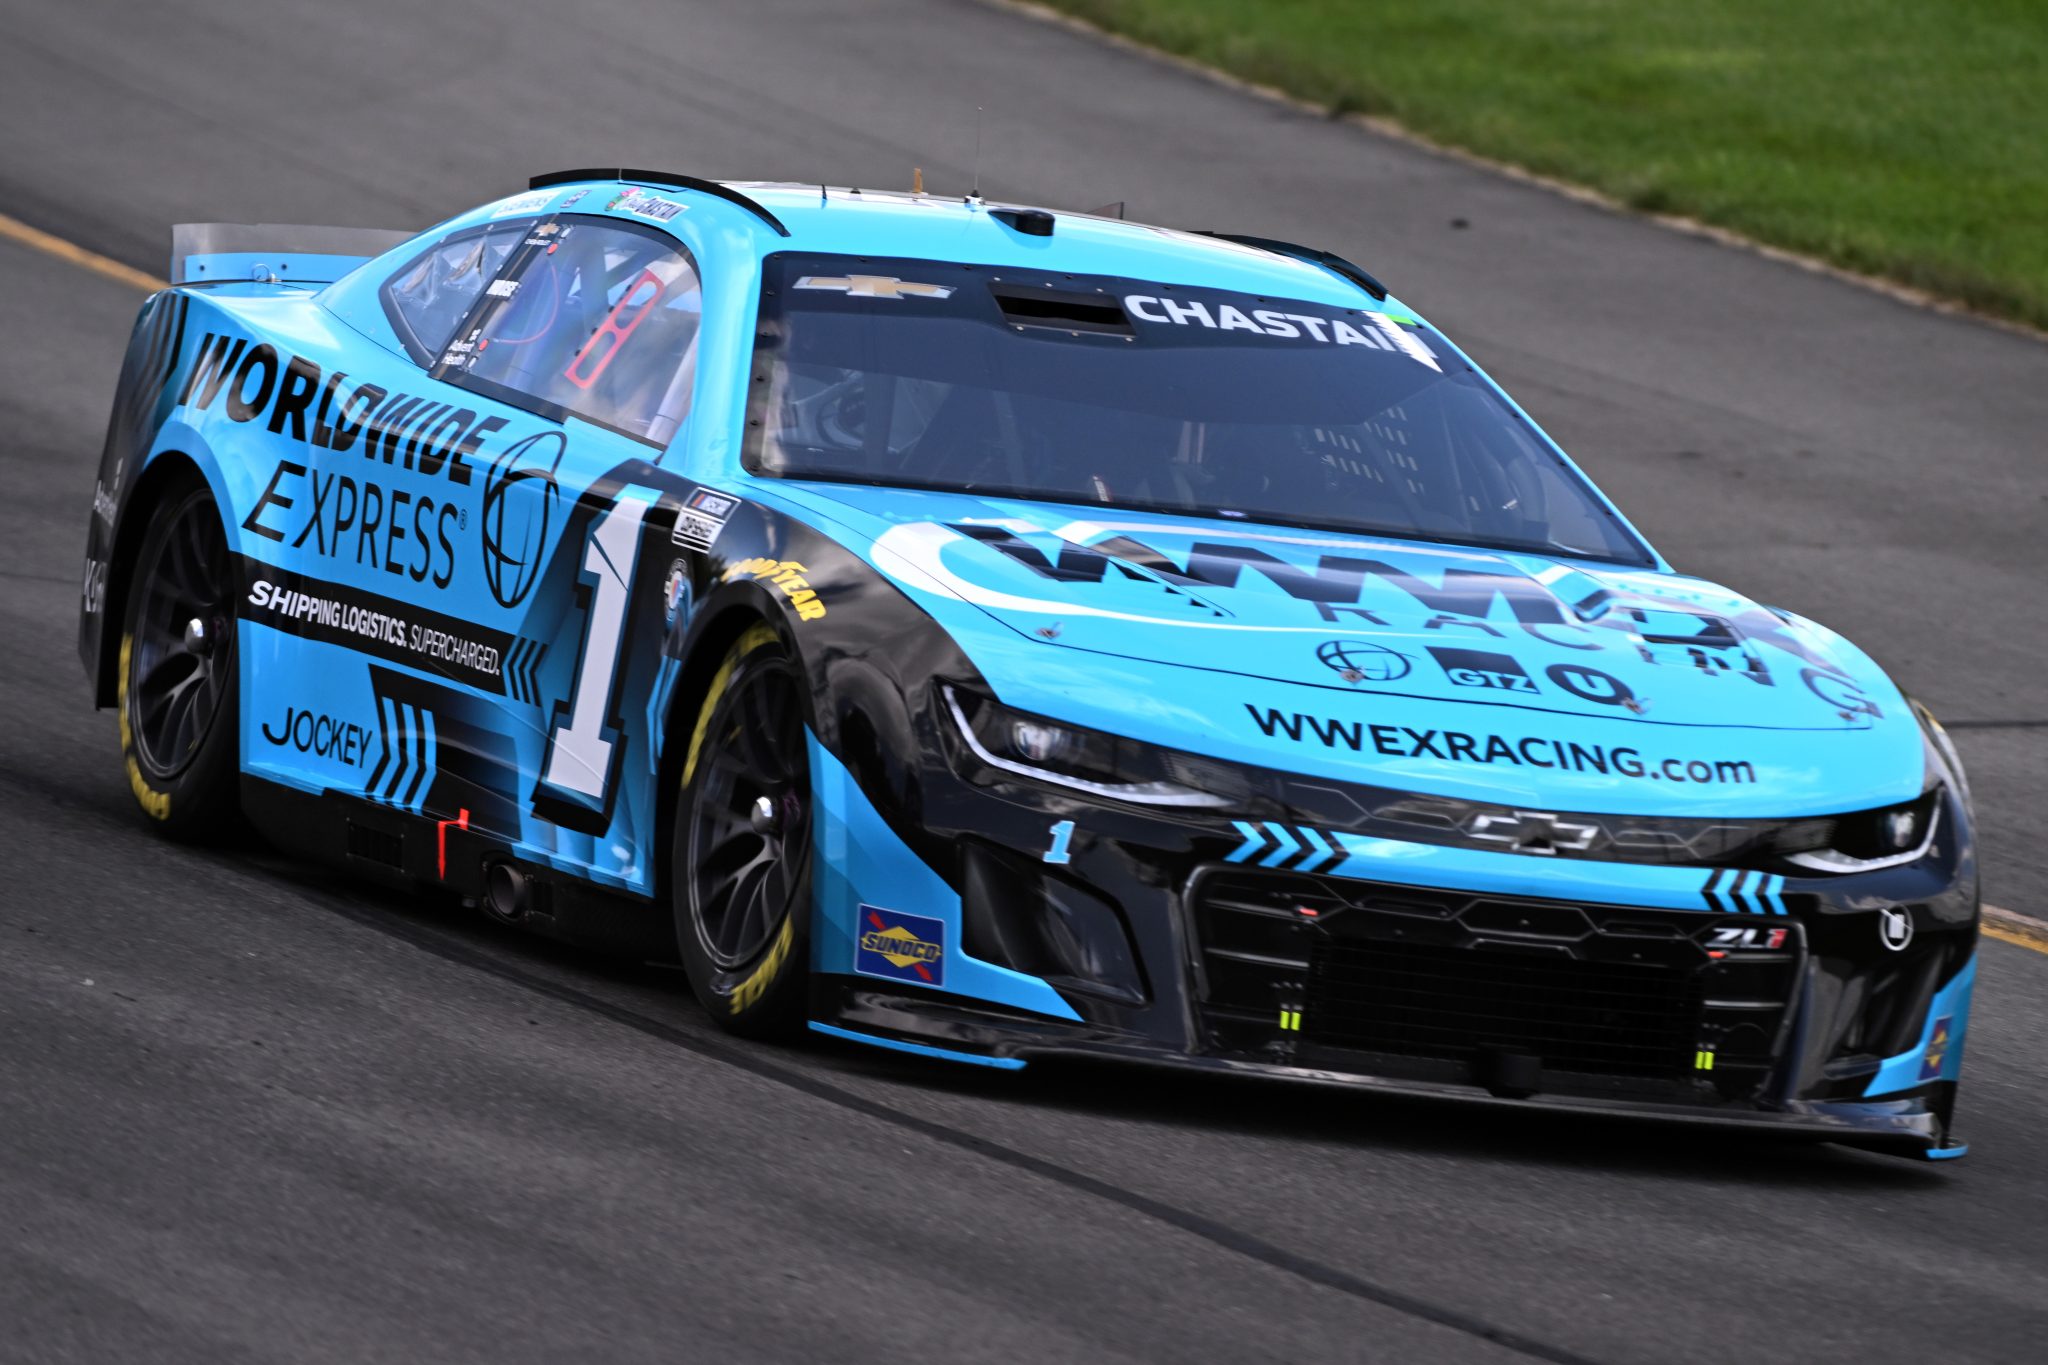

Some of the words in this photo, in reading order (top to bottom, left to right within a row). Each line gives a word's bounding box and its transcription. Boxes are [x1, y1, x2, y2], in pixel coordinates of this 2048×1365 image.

[178, 332, 511, 487] WORLDWIDE
[248, 580, 341, 628] SHIPPING
[341, 603, 408, 647] LOGISTICS.
[409, 624, 501, 676] SUPERCHARGED.
[546, 483, 663, 799] 1
[1448, 666, 1541, 694] GTZ
[261, 706, 373, 769] JOCKEY
[1244, 703, 1757, 784] WWEXRACING.com
[1043, 820, 1076, 864] 1
[863, 933, 940, 960] SUNOCO
[1704, 927, 1788, 949] ZL1
